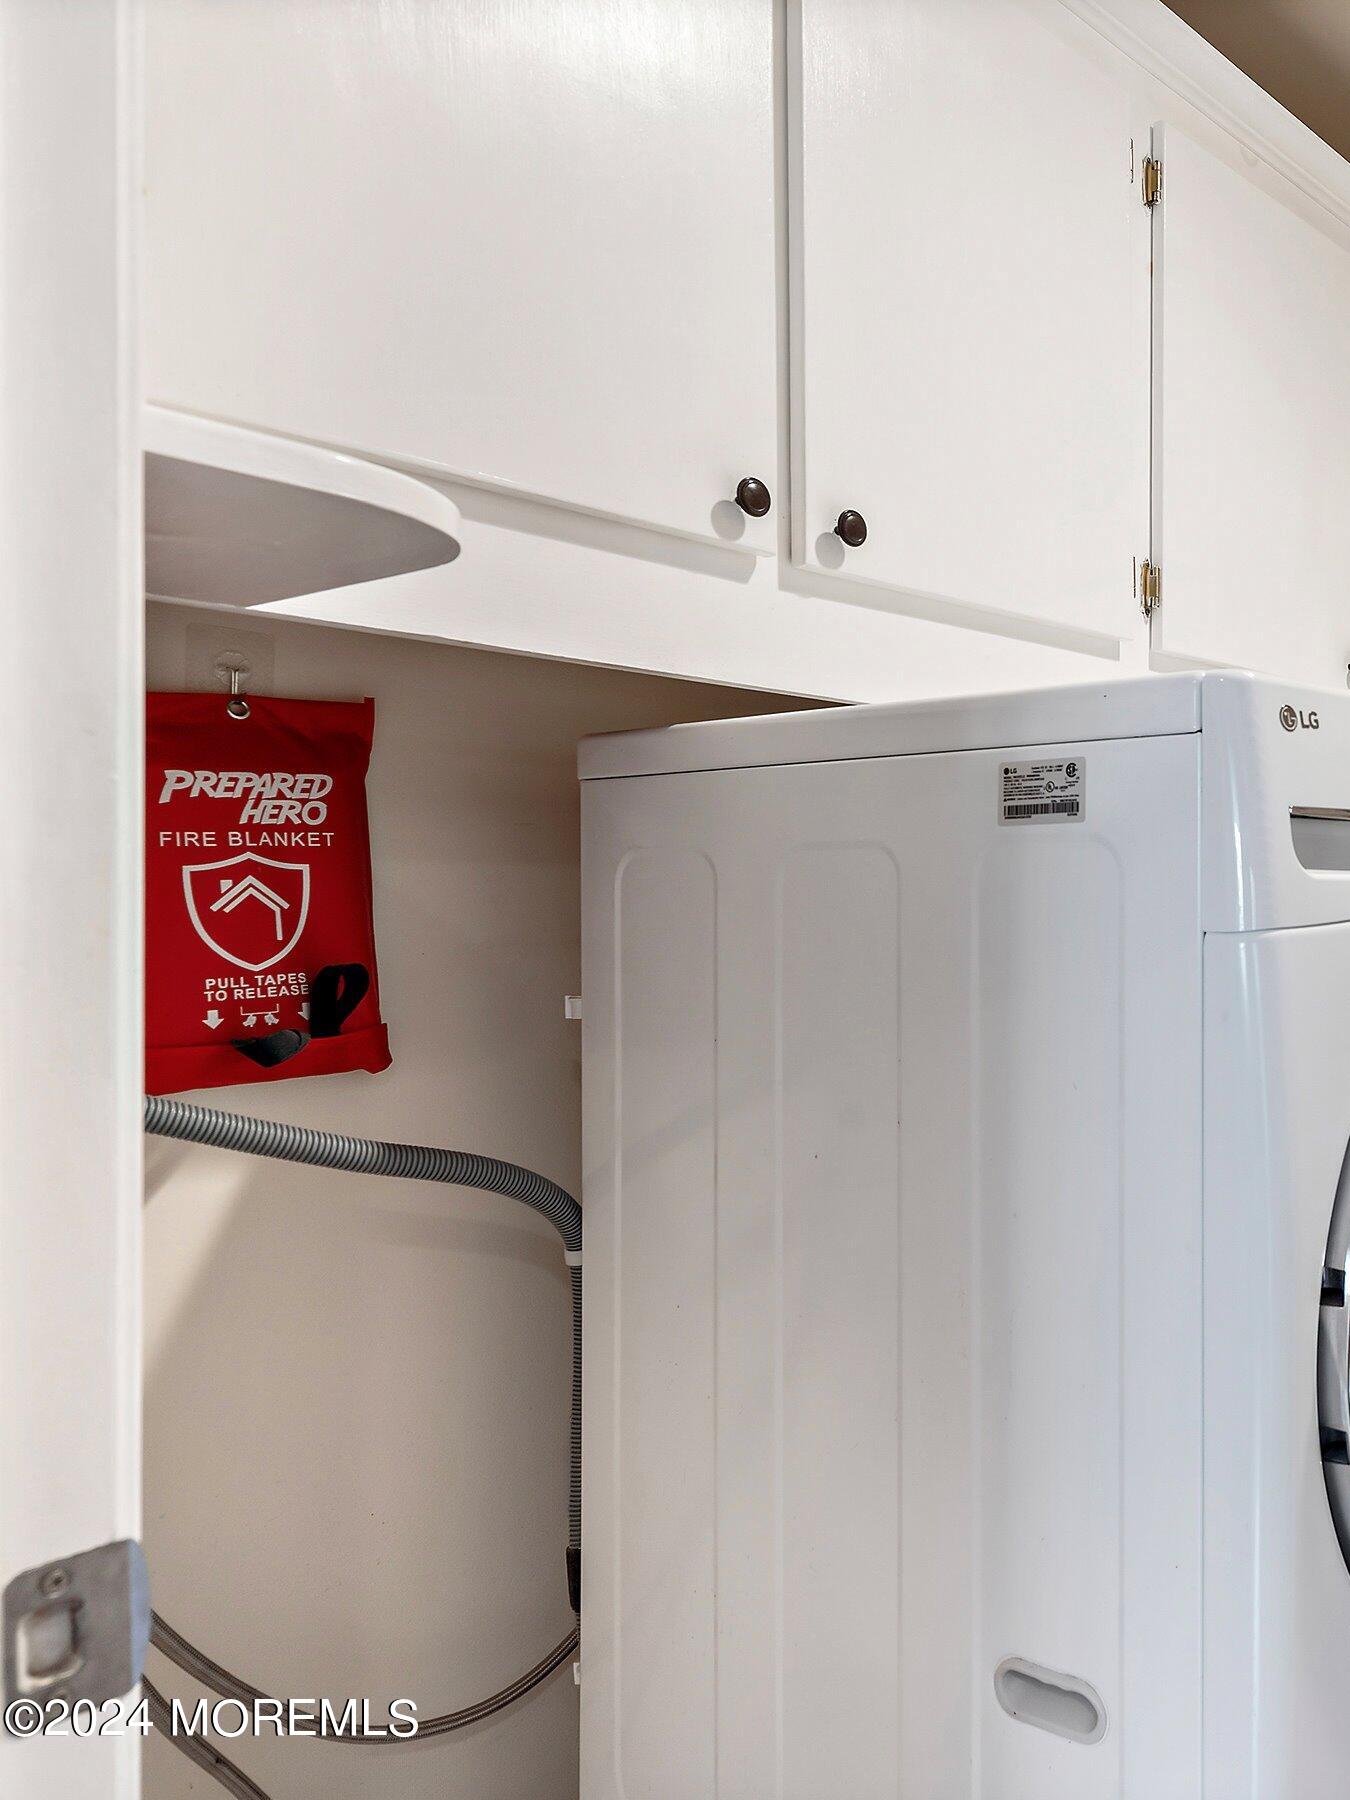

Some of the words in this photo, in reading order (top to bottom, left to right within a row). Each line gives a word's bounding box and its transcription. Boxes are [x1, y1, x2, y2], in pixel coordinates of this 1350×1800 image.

[158, 769, 333, 804] PREPARED
[238, 798, 328, 826] HERO
[159, 831, 218, 847] FIRE
[228, 831, 335, 847] BLANKET
[205, 976, 250, 990] PULL
[254, 972, 308, 986] TAPES
[204, 990, 228, 1002] TO
[233, 984, 310, 1000] RELEASE
